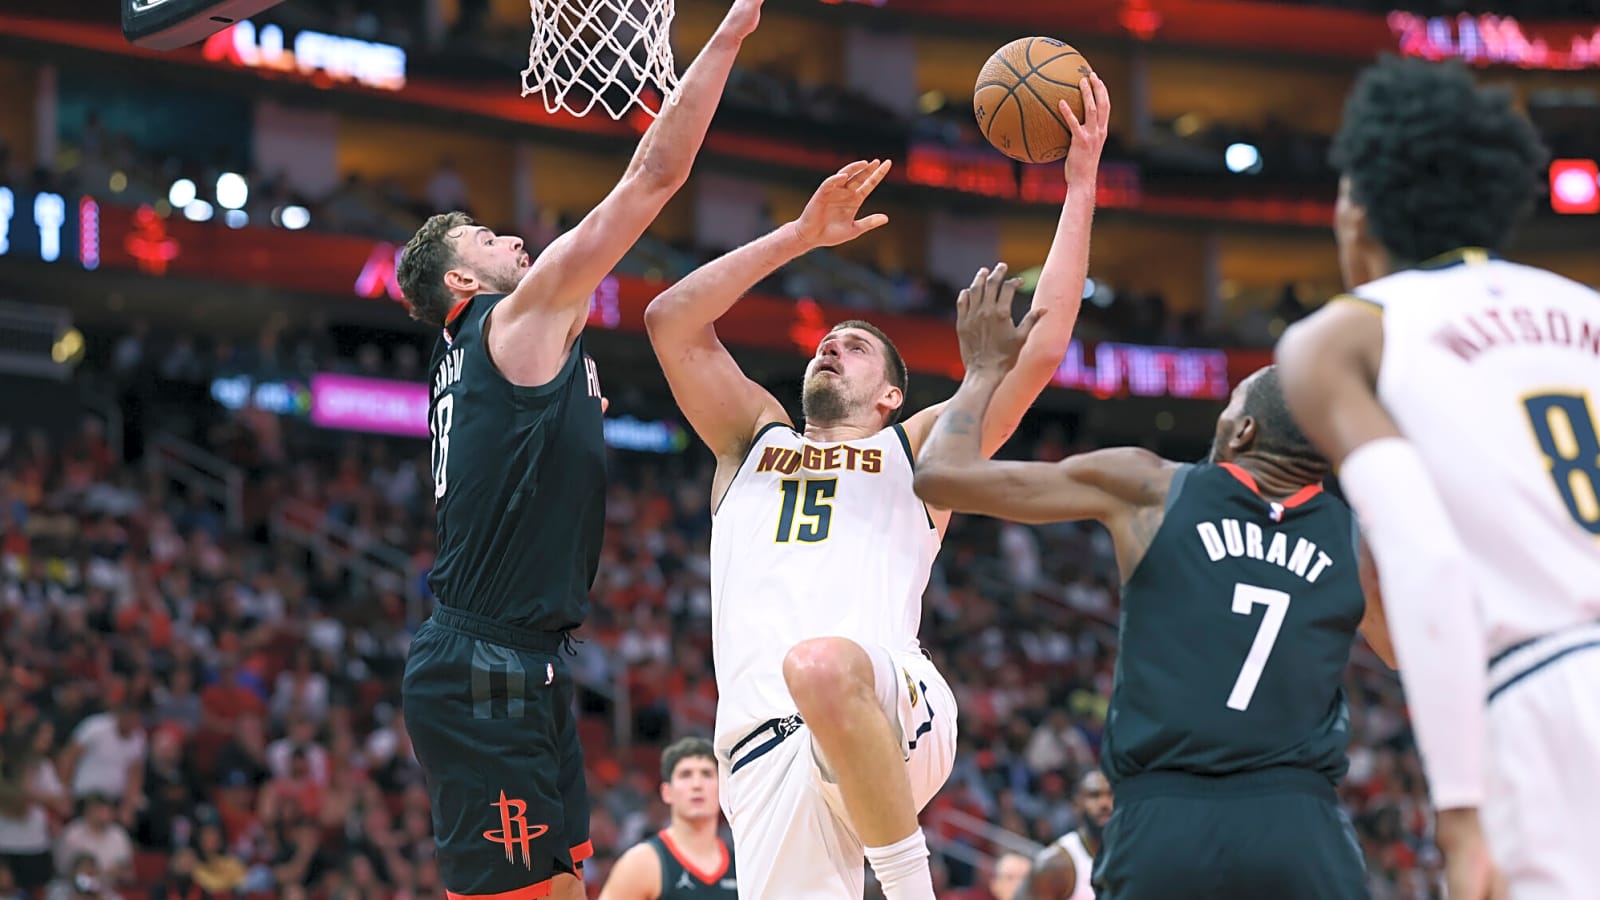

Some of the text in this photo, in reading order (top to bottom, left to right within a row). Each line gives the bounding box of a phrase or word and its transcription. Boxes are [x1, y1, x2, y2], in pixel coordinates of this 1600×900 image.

[755, 443, 882, 475] NUGETS
[1518, 388, 1600, 537] 8
[773, 476, 839, 545] 15
[1196, 518, 1334, 583] DURANT
[1226, 582, 1291, 711] 7
